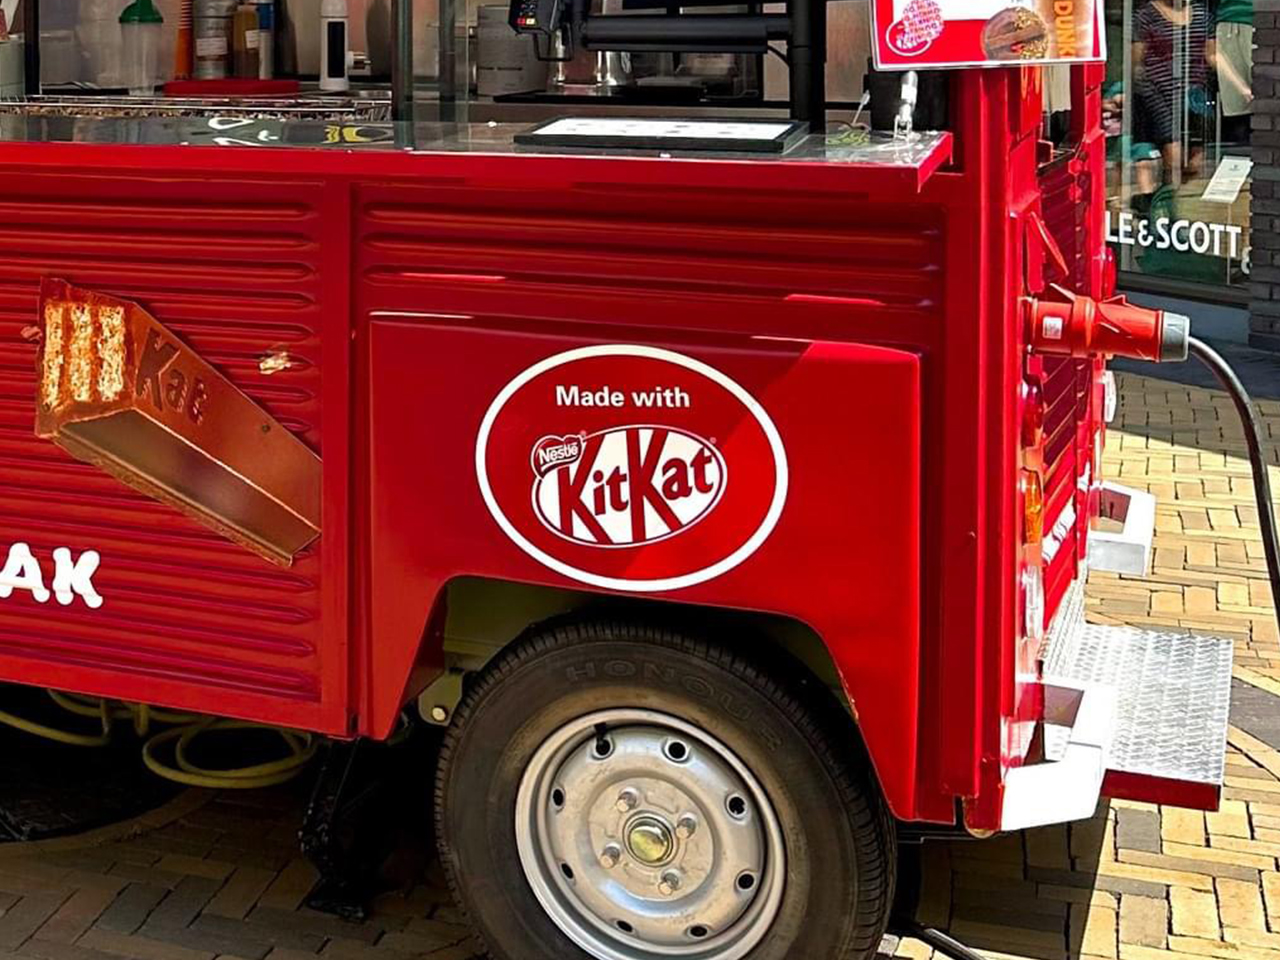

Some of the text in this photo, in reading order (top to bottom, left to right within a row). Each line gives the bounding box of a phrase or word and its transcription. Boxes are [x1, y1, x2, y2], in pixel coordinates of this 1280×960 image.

[1155, 216, 1242, 258] SCOTT
[555, 385, 690, 408] Made with
[556, 430, 714, 544] KitKat
